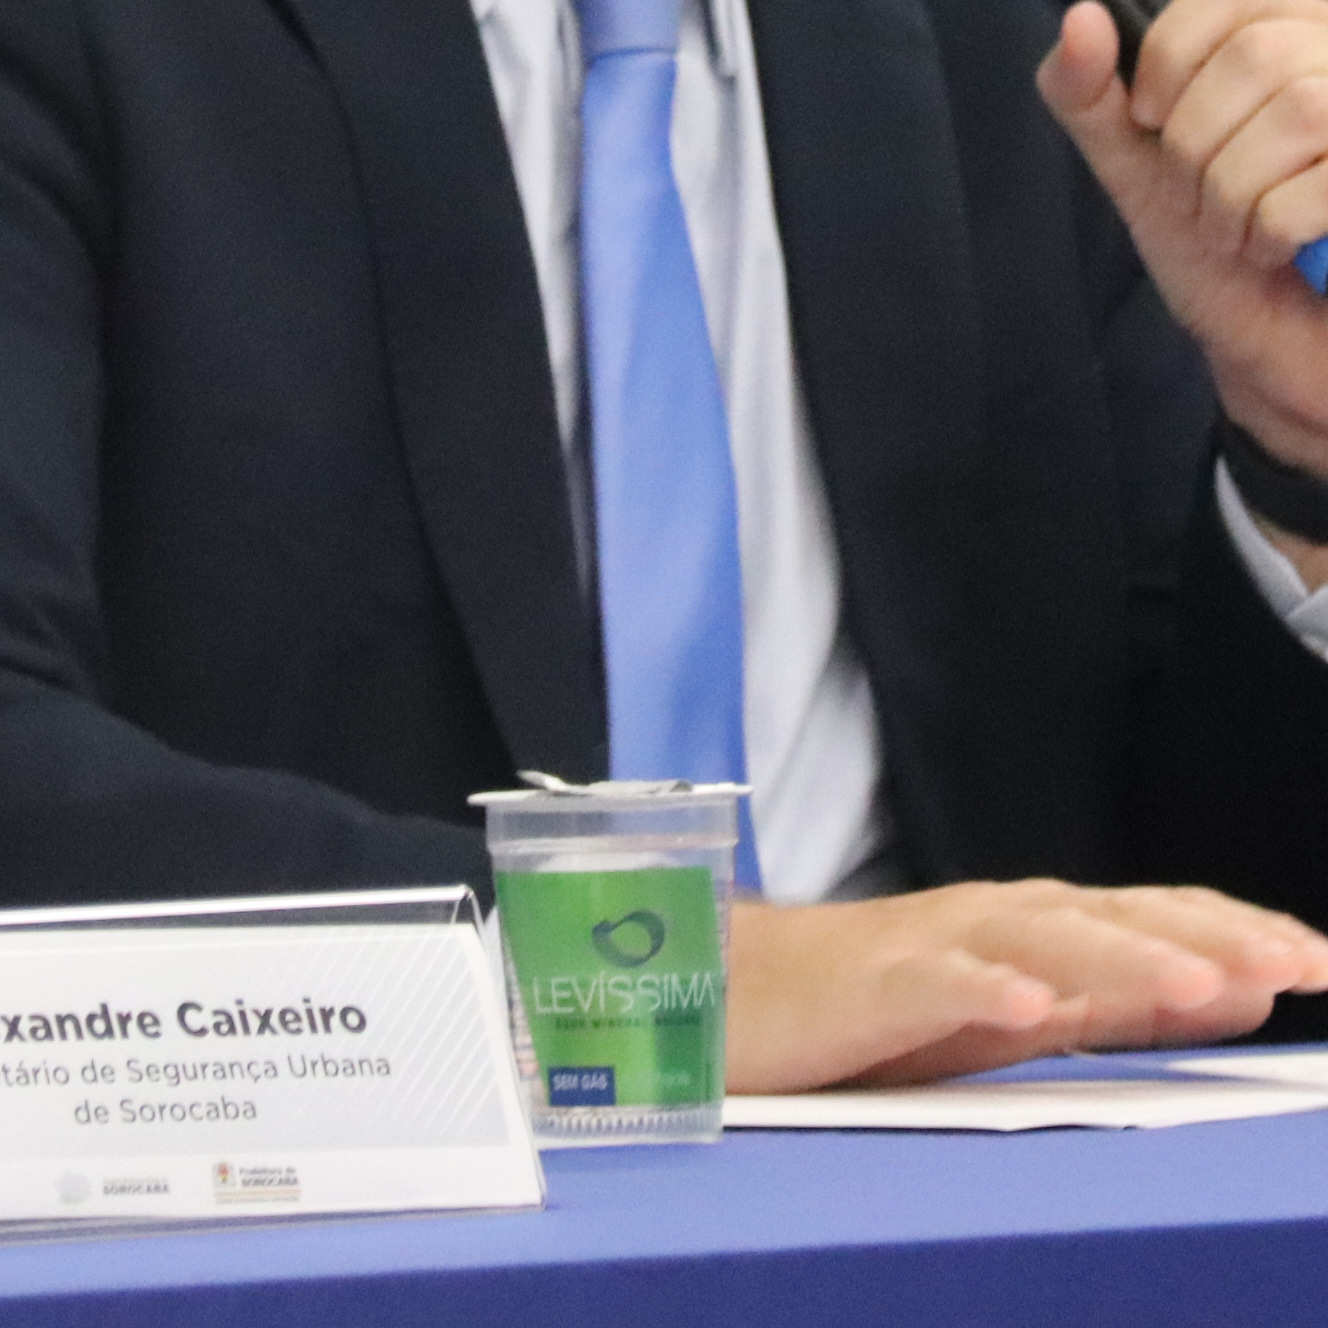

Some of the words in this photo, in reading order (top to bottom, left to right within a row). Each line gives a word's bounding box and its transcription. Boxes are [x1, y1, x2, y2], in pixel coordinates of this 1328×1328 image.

[532, 970, 716, 1015] LEVÍSSIMA
[176, 997, 368, 1038] Caixeiro
[79, 1058, 116, 1085] de
[125, 1057, 280, 1088] Segurança
[286, 1052, 392, 1079] Urbana
[73, 1098, 110, 1126] de
[118, 1094, 258, 1124] Sorocaba
